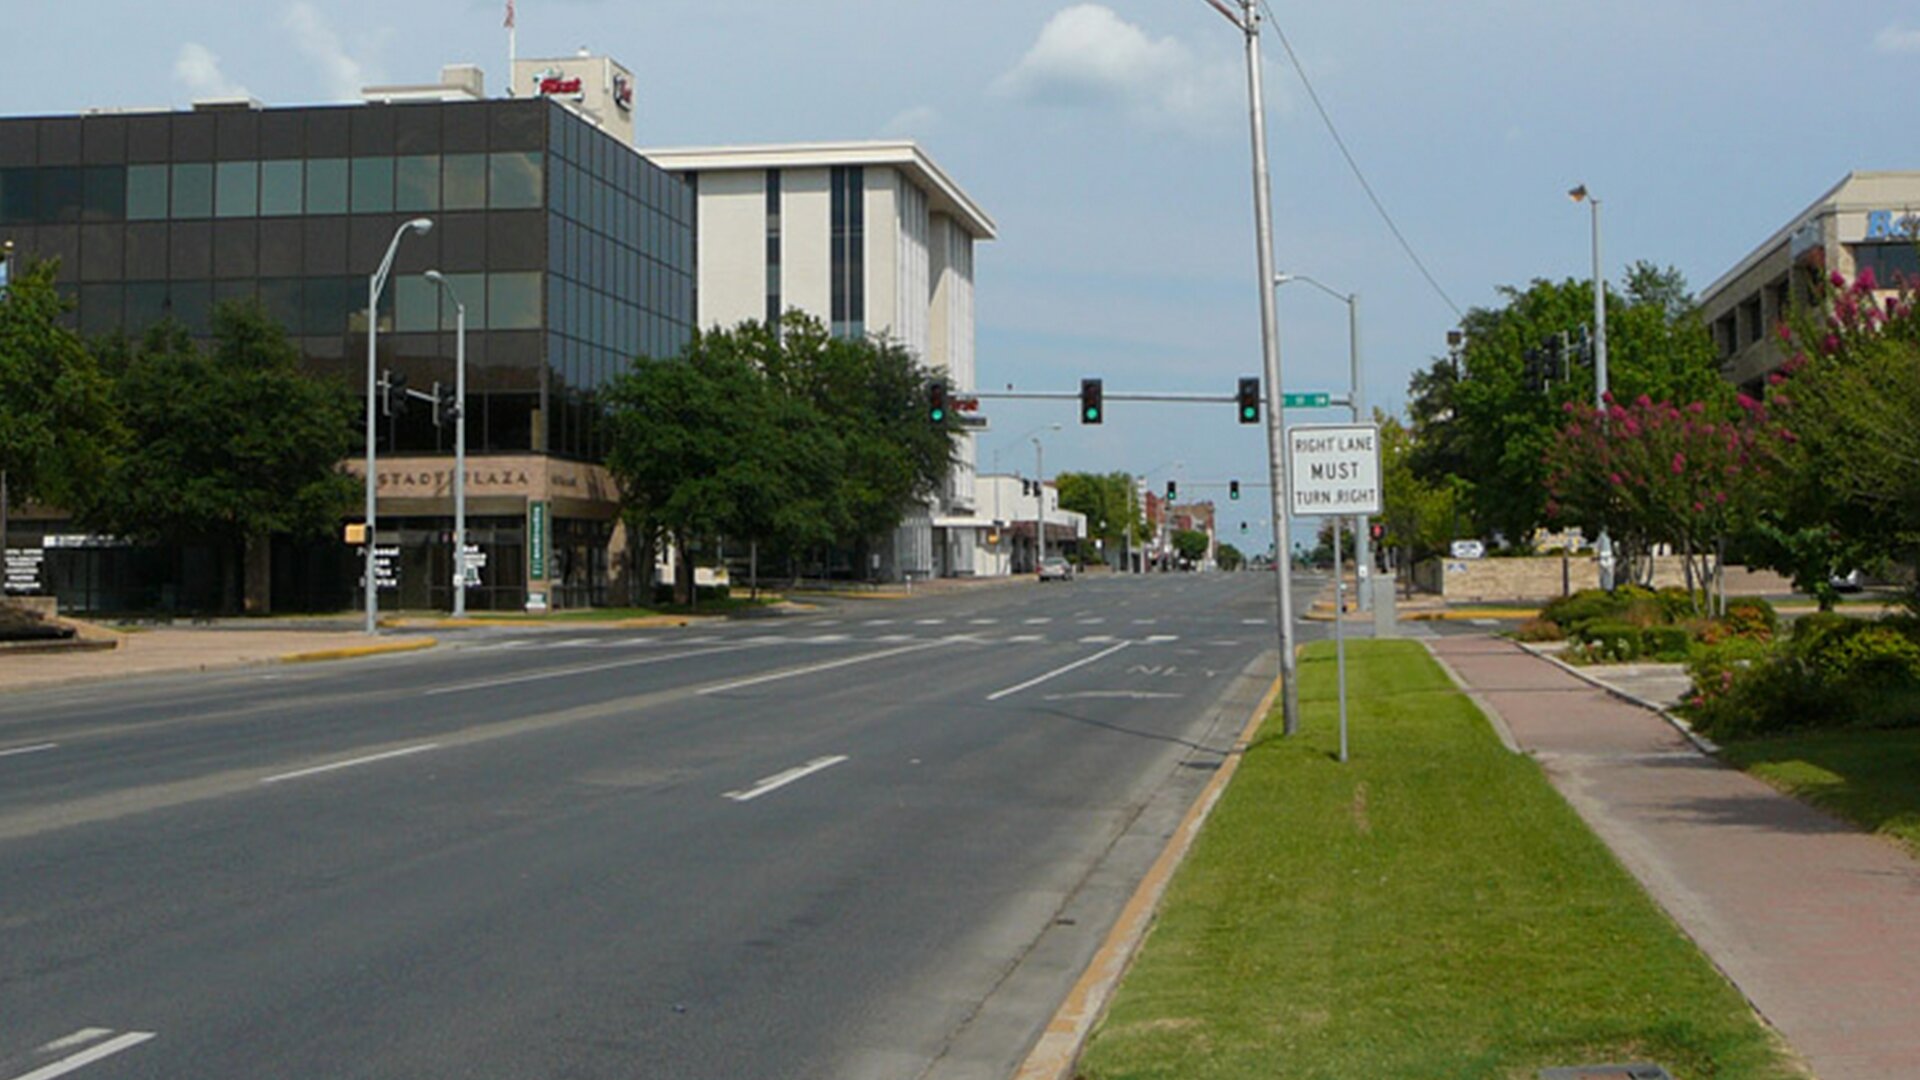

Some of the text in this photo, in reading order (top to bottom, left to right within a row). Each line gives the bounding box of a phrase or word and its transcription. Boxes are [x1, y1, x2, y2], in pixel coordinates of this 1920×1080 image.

[1295, 436, 1373, 454] RIGHT LANE
[1311, 462, 1359, 480] MUST
[1296, 488, 1376, 505] TURN RIGHT
